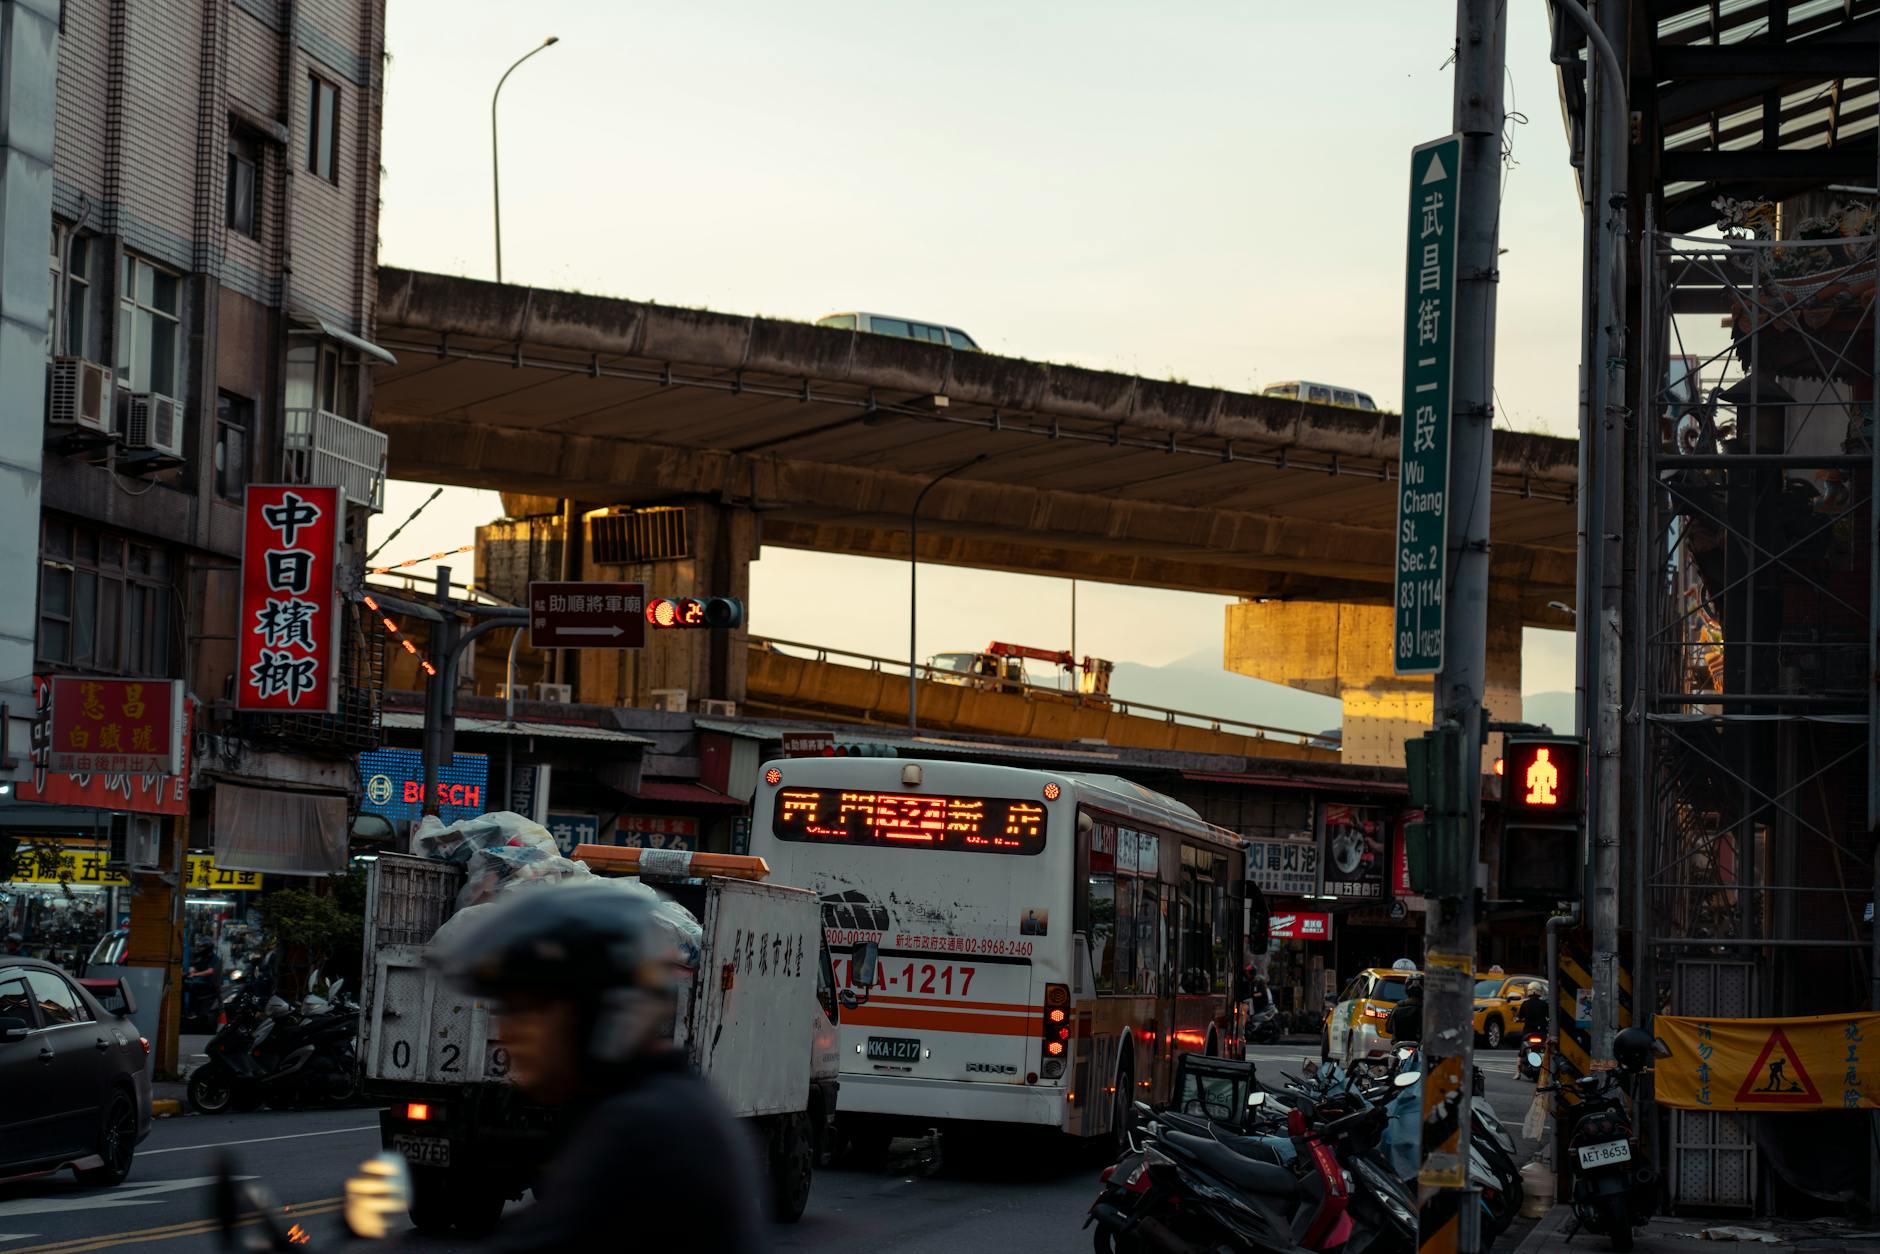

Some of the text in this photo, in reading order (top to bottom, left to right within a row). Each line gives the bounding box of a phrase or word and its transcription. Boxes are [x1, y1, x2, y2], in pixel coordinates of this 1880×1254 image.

[1414, 191, 1445, 453] 武昌街二段
[1404, 461, 1425, 485] Wu
[1403, 489, 1443, 517] Chang
[1402, 521, 1419, 543] St.
[1401, 545, 1438, 572] Sec. 2
[249, 491, 322, 706] 中日檳榔
[549, 594, 641, 613] 助順將軍廟
[1400, 580, 1415, 609] 83
[1422, 577, 1441, 607] 114
[1399, 631, 1414, 659] 89
[59, 755, 162, 772] 請由後門出入
[895, 934, 1033, 957] 新北市政府交通局 02-8968-2460
[868, 1039, 920, 1059] KKA-1217
[1843, 1021, 1864, 1108] 施工危險
[1583, 1145, 1628, 1164] AET-8653
